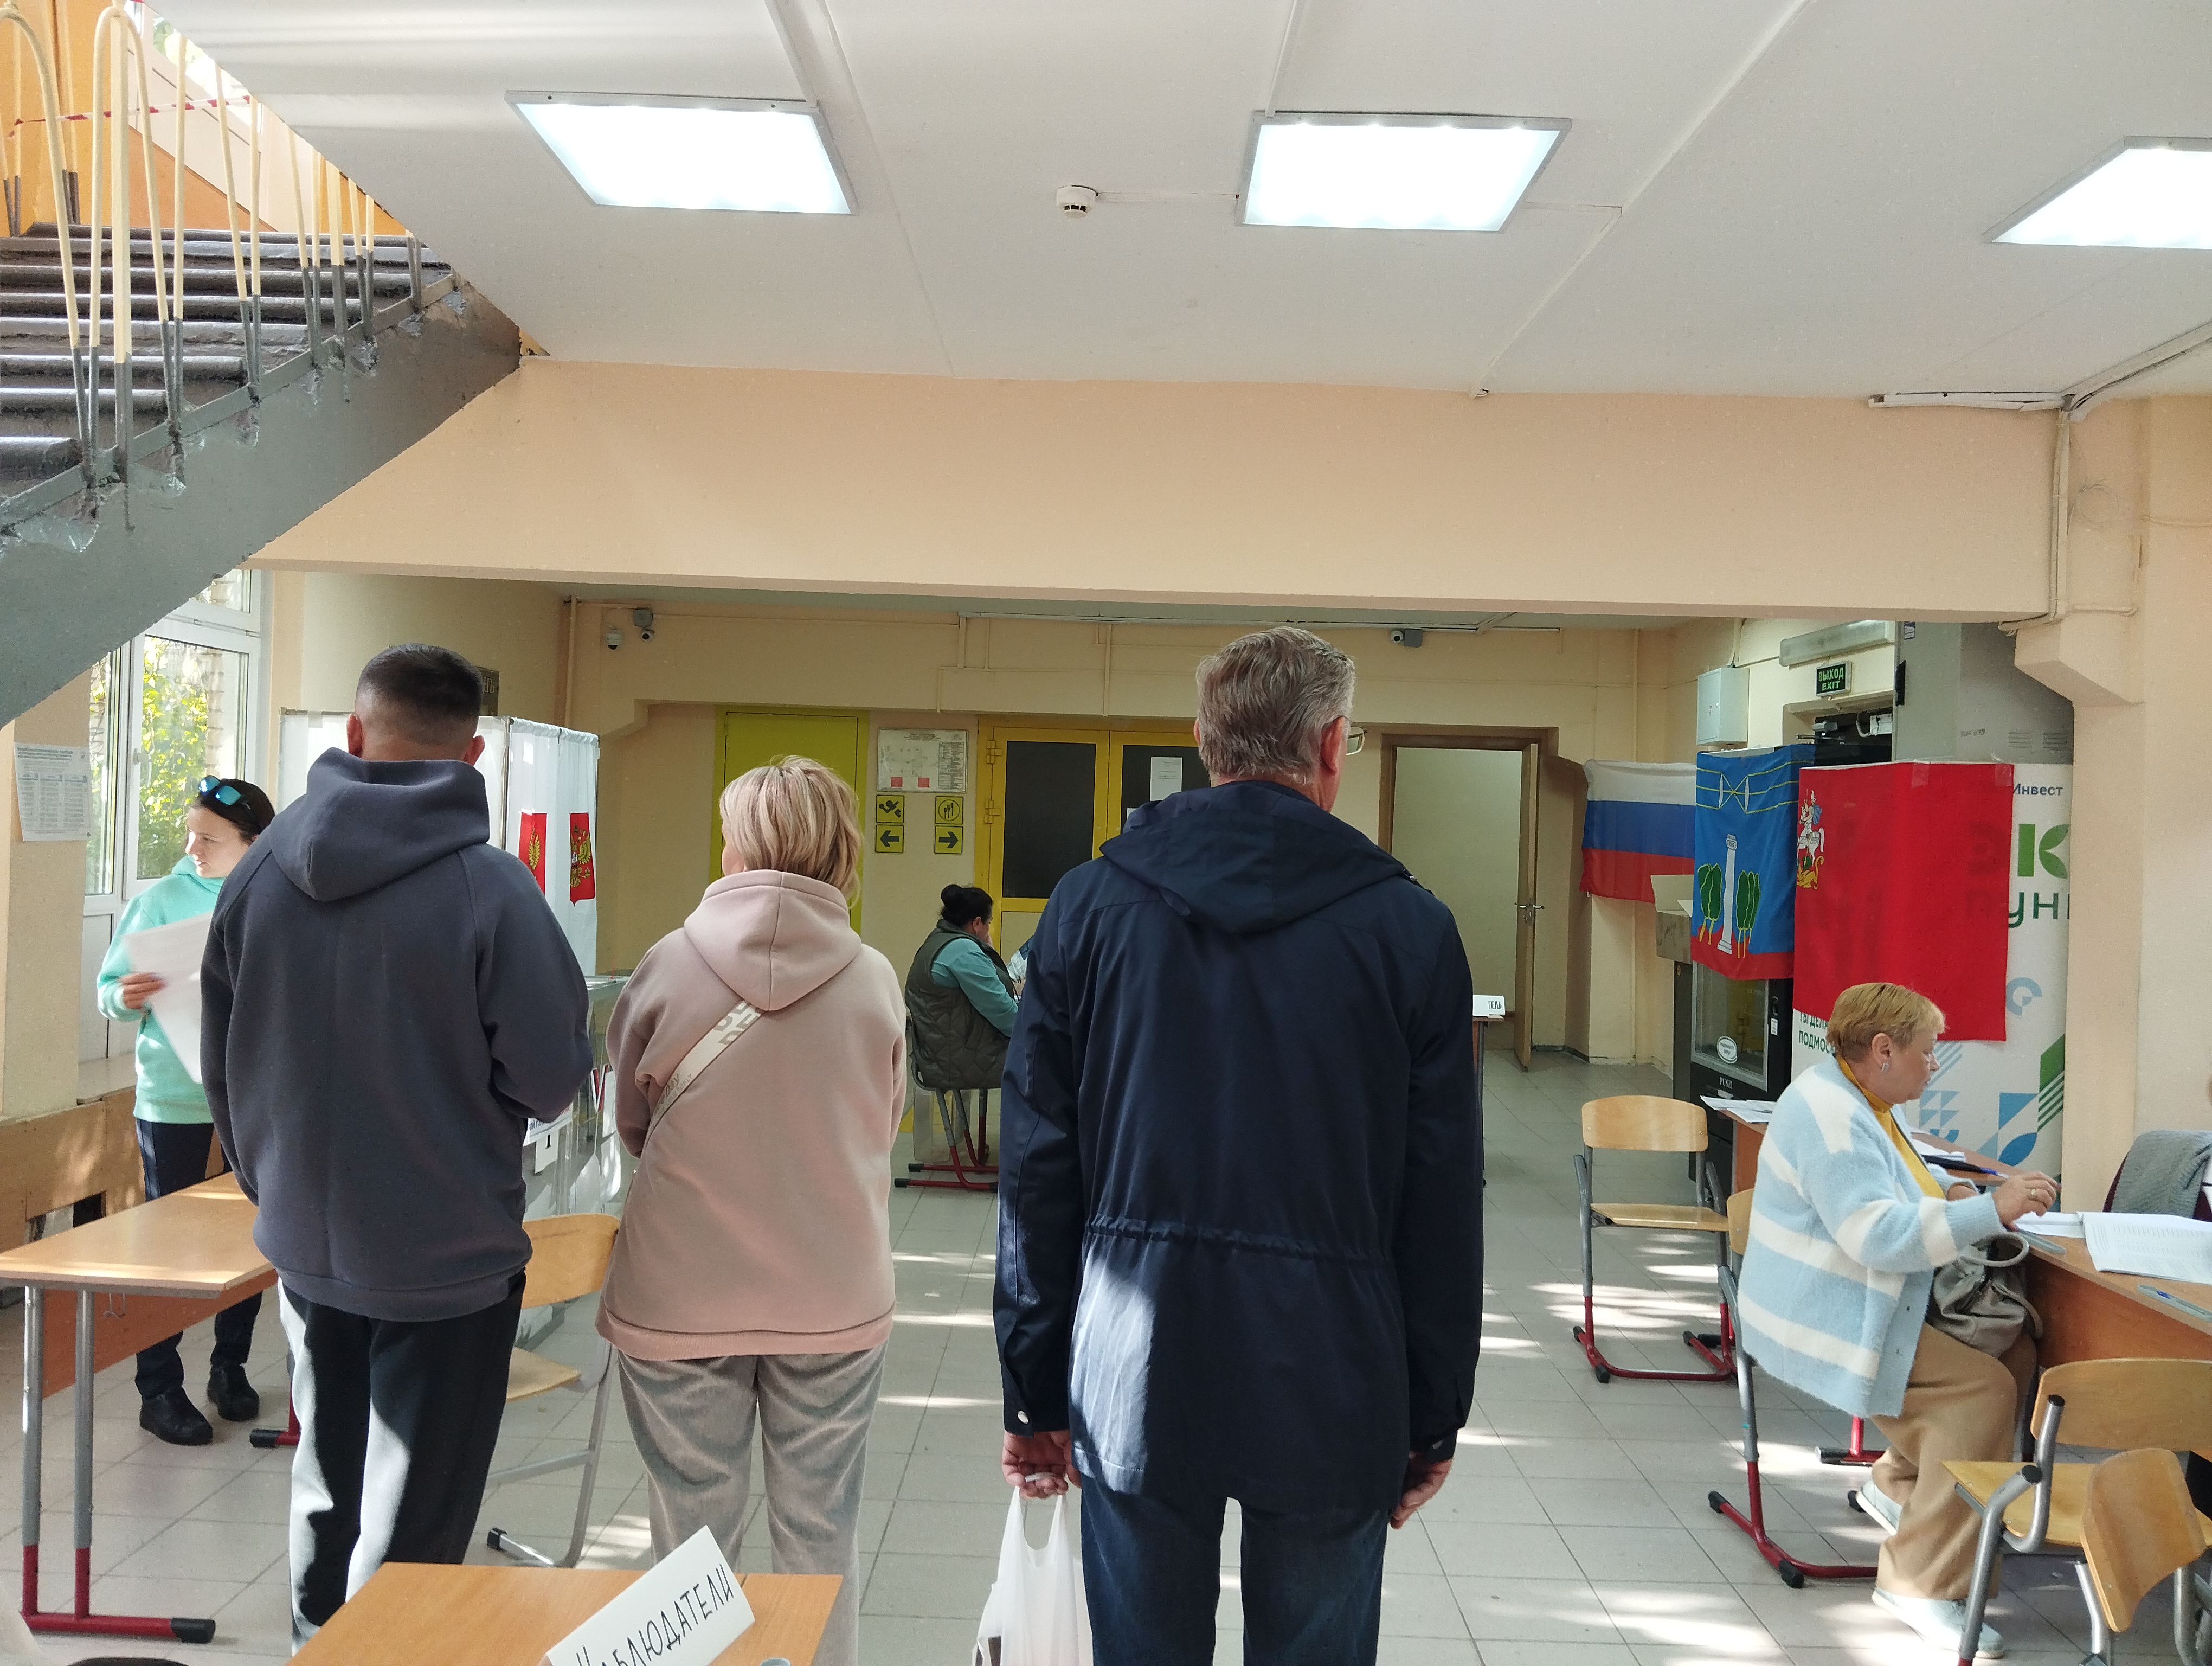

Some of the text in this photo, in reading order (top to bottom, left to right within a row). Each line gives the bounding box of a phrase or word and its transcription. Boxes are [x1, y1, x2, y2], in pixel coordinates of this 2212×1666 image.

[1818, 667, 1844, 682] ВЫХОД
[1822, 681, 1840, 691] EXIT
[2013, 784, 2063, 796] Инвест
[576, 1564, 734, 1666] БЛЮДАТЕЛИ
